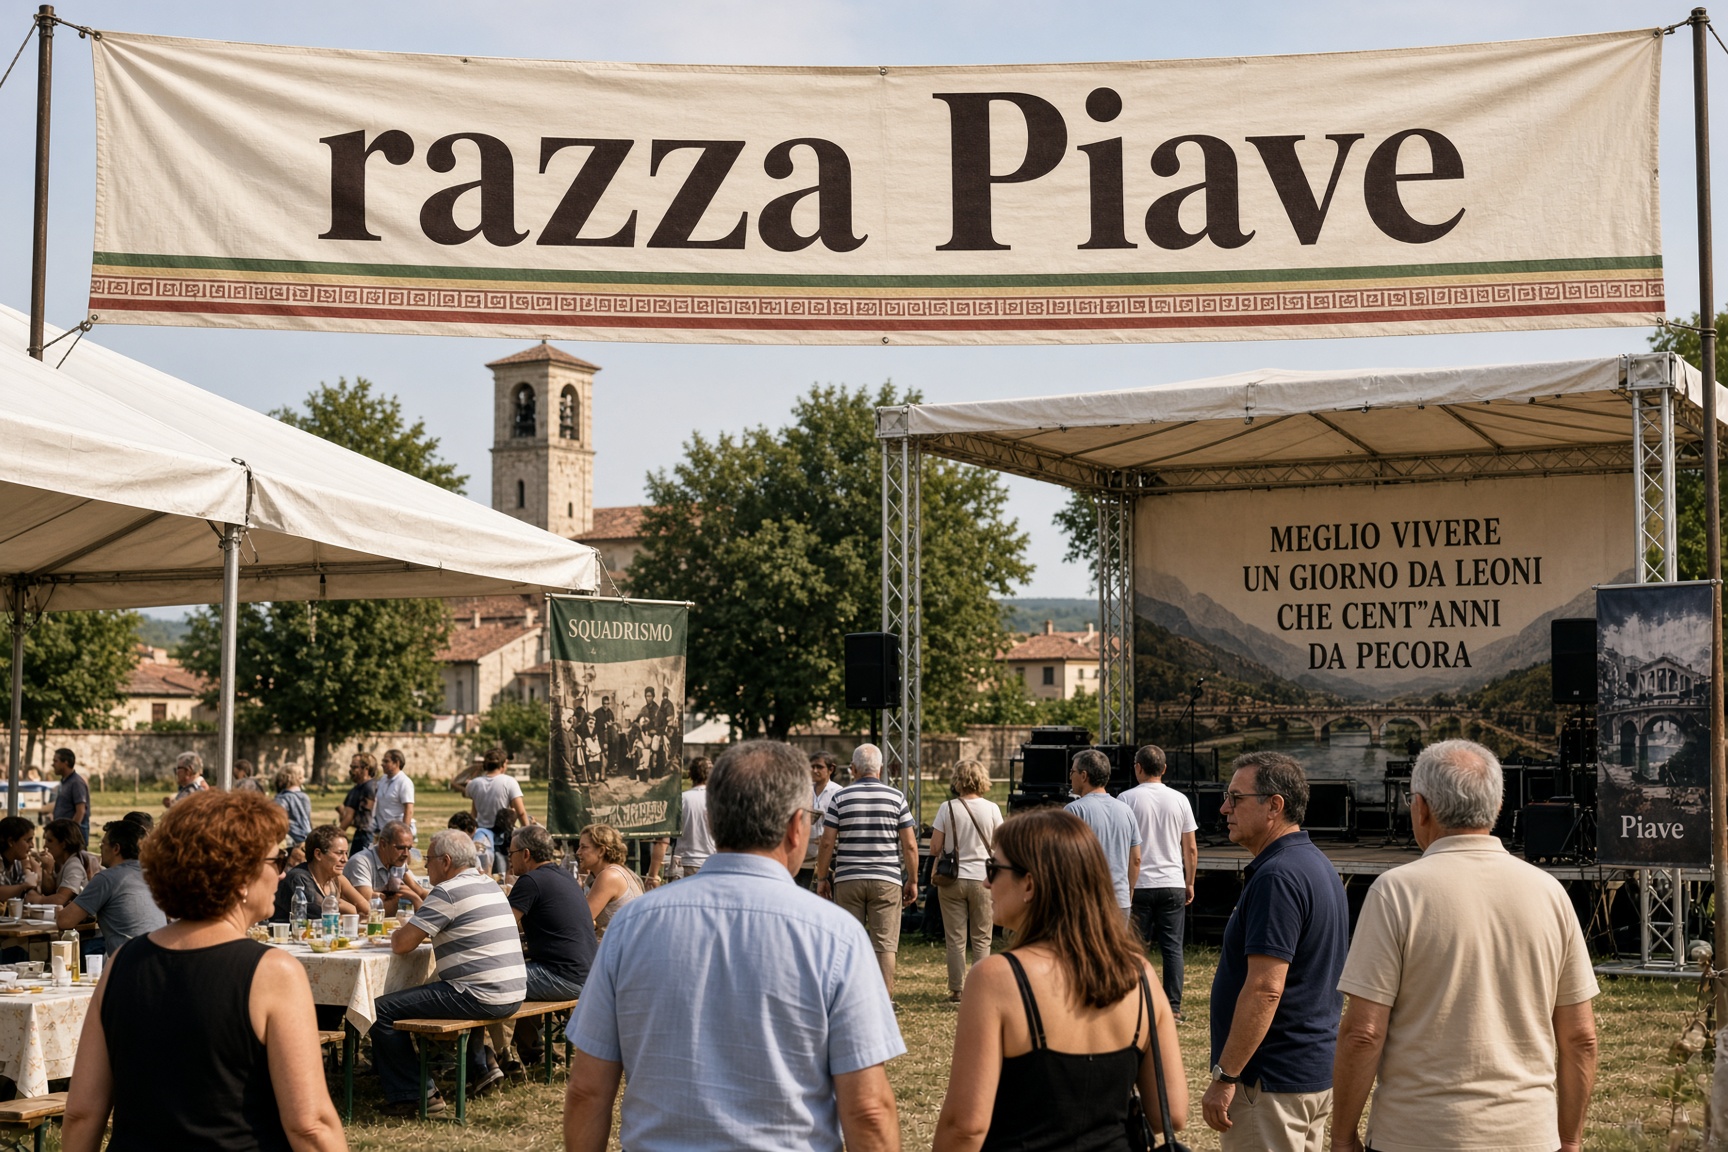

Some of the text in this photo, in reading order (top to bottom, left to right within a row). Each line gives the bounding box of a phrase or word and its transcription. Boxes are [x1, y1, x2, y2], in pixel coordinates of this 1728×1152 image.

[318, 87, 1466, 253] razza Piave
[1269, 517, 1502, 553] MEGLIO VIVERE
[1242, 556, 1543, 593] UN GIORNO DA LEONI
[568, 618, 673, 642] SQUADRISMO
[1276, 603, 1333, 631] CHE
[1307, 640, 1473, 670] DA PECORA
[1620, 815, 1684, 839] Piave
